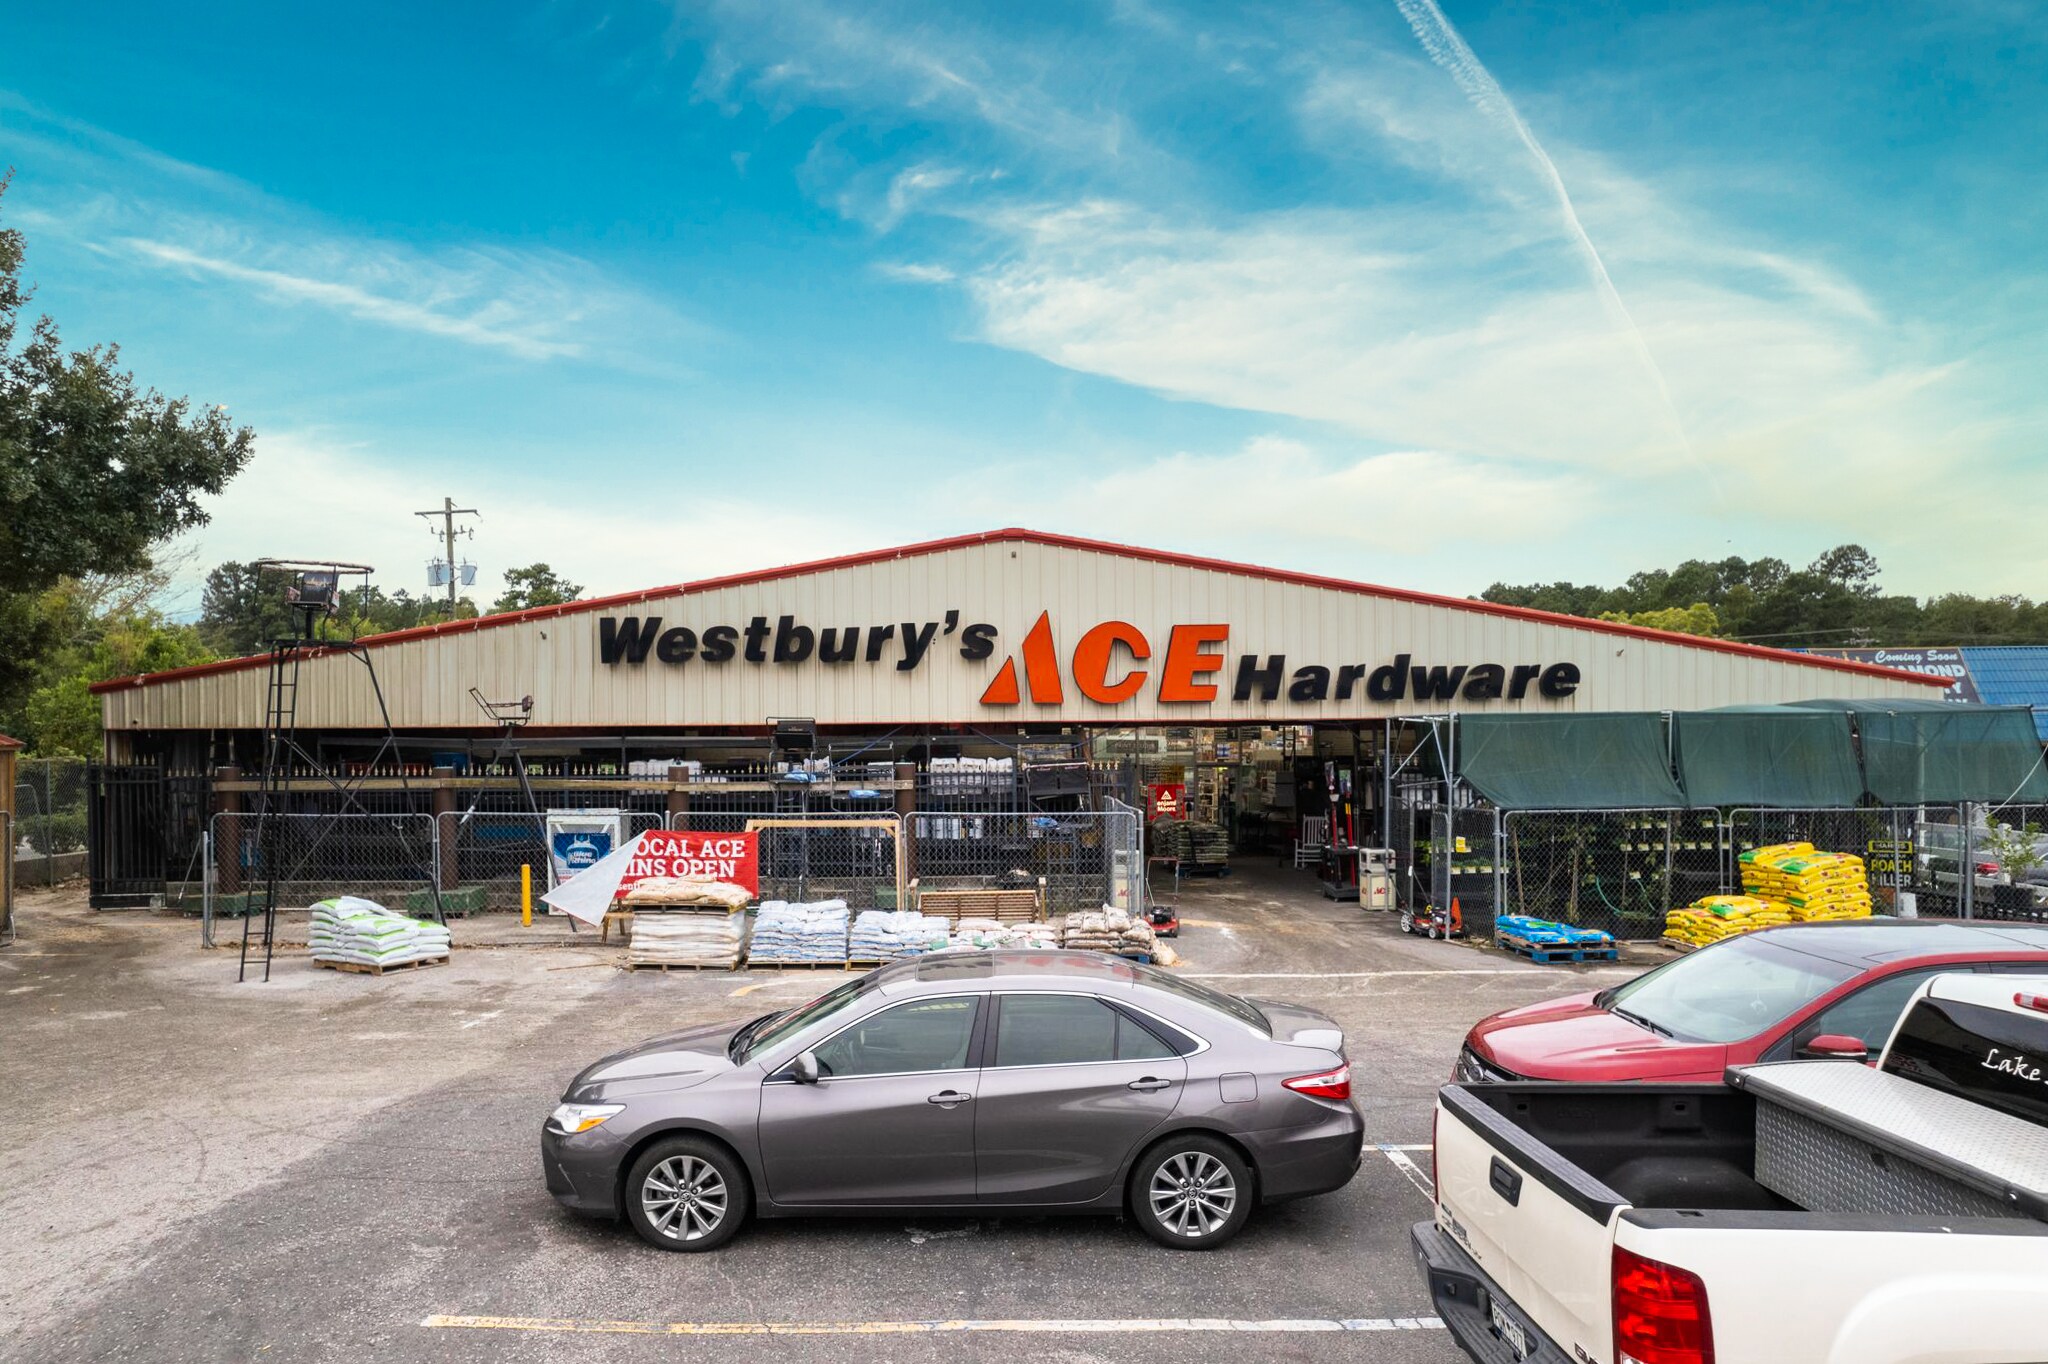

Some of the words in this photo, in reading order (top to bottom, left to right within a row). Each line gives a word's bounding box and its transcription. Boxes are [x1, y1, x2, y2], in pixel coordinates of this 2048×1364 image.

[599, 609, 998, 671] Westbury's
[980, 610, 1230, 704] ACE
[1233, 654, 1581, 702] Hardware
[1875, 650, 1923, 664] Coming
[1927, 650, 1958, 662] Soon
[635, 839, 694, 858] OCAL
[699, 840, 745, 858] ACE
[672, 859, 736, 878] OPEN
[1981, 1048, 2041, 1081] Lake
